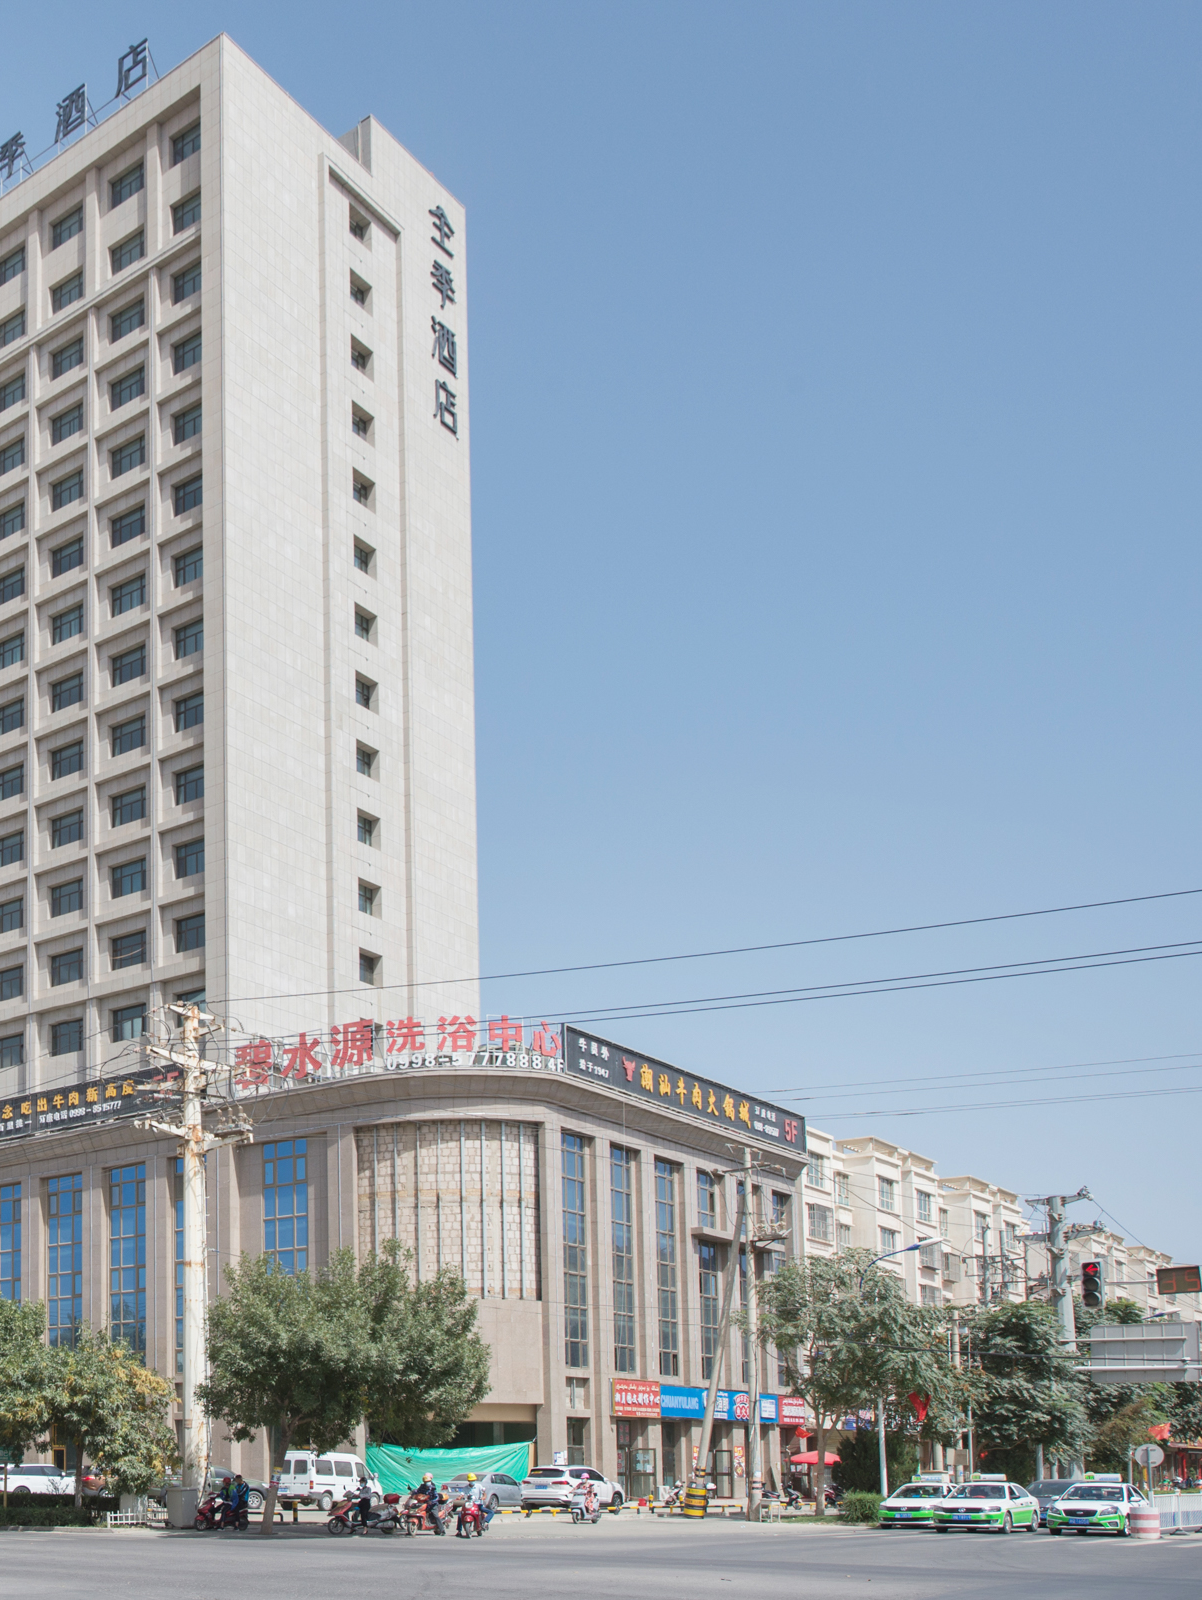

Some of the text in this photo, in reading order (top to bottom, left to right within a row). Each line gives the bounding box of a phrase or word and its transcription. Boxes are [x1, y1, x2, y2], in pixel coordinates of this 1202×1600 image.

[428, 204, 459, 440] 全季酒店
[235, 1014, 562, 1090] 碧水源洗浴中心
[578, 1037, 610, 1061] 牛员外
[639, 1063, 752, 1129] 潮汕牛肉火锅城
[784, 1118, 798, 1143] 5F
